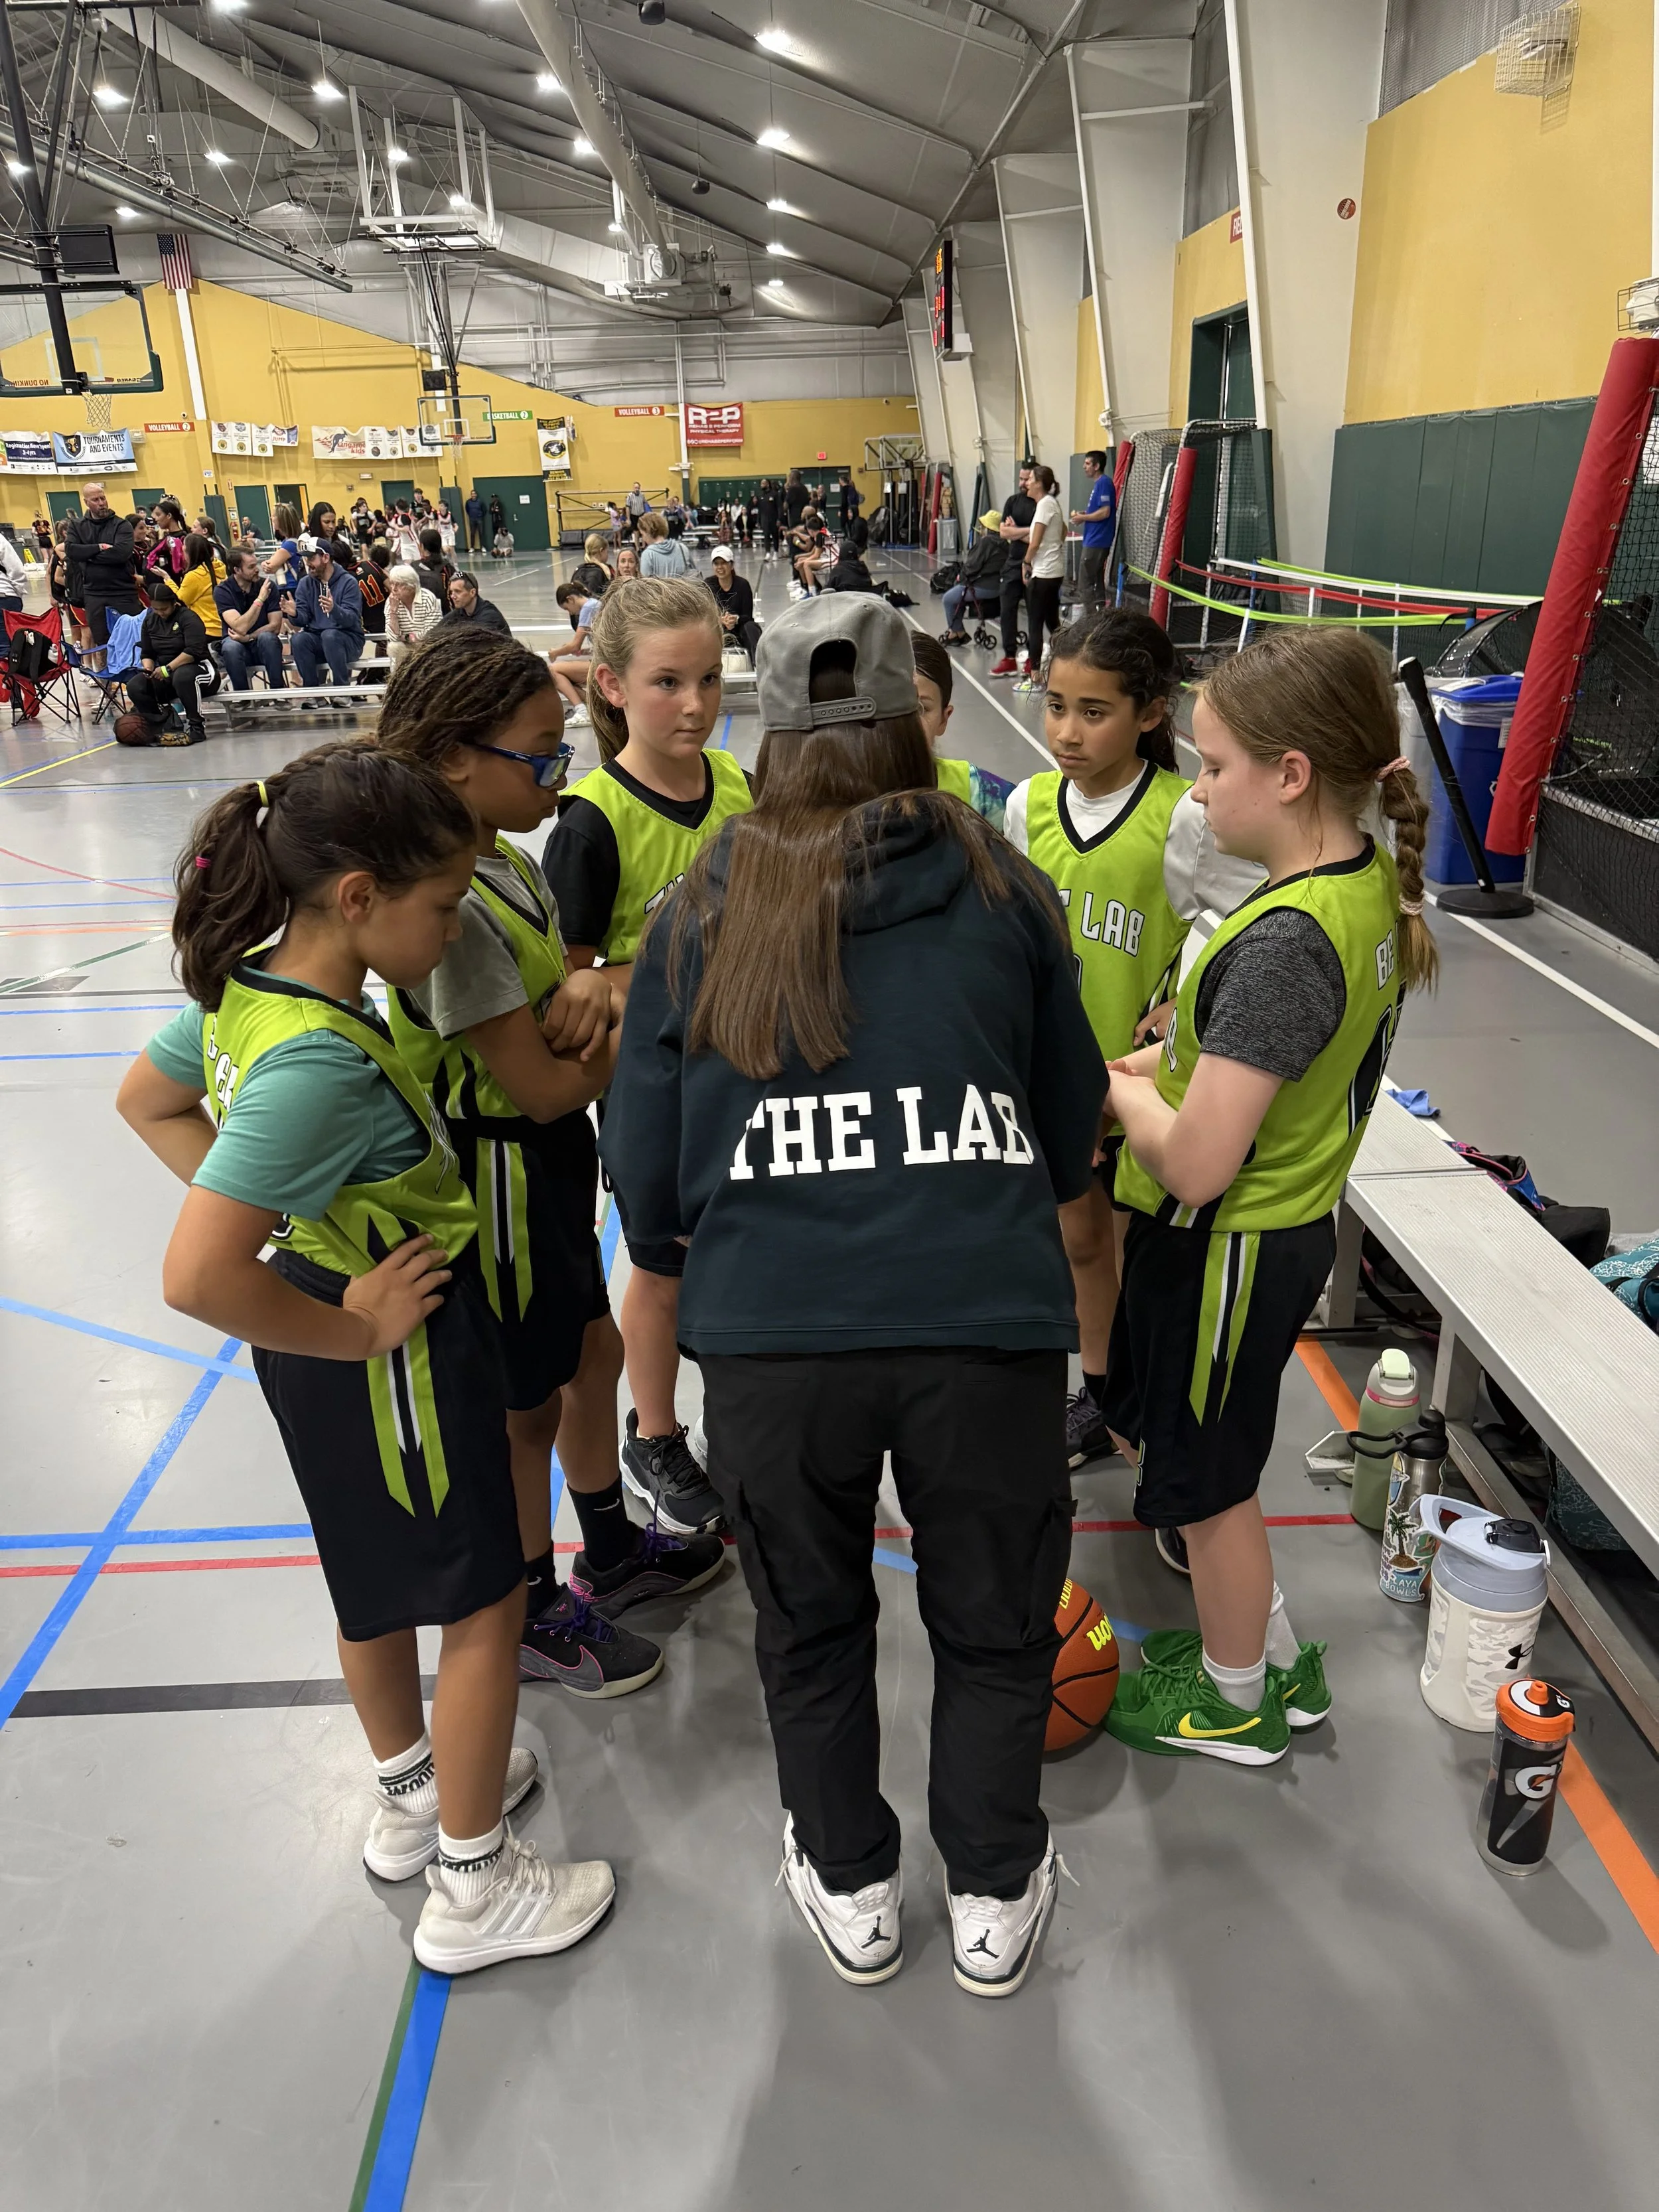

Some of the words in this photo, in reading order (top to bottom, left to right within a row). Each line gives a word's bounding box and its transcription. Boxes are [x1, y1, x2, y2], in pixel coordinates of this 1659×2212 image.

[83, 434, 125, 445] TOURNAMENTS
[102, 443, 124, 452] EVENTS
[358, 574, 385, 607] 11
[1080, 891, 1145, 957] LAB
[730, 1091, 876, 1180] THE
[896, 1084, 1034, 1165] LAB
